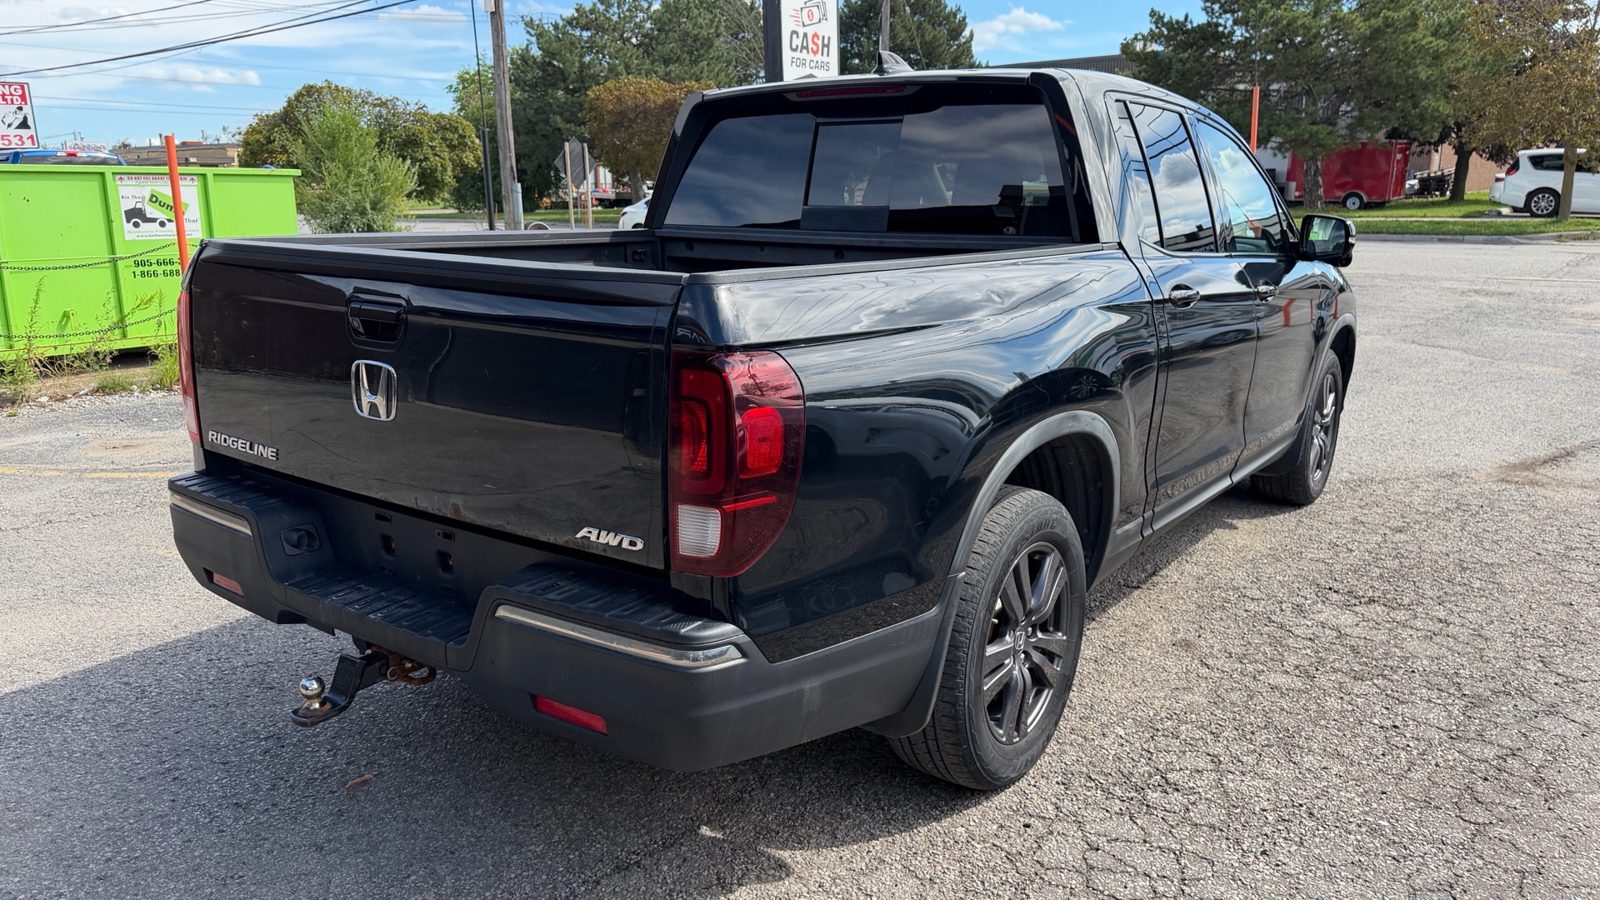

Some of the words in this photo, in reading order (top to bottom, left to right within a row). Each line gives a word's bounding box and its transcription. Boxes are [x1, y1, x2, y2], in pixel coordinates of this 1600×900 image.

[789, 30, 831, 57] CA$H
[790, 56, 807, 69] FOR
[809, 59, 830, 71] CARS
[0, 95, 25, 105] LTD.
[0, 134, 36, 147] 531
[208, 430, 279, 461] RIDGELINE
[575, 526, 644, 551] AWD
